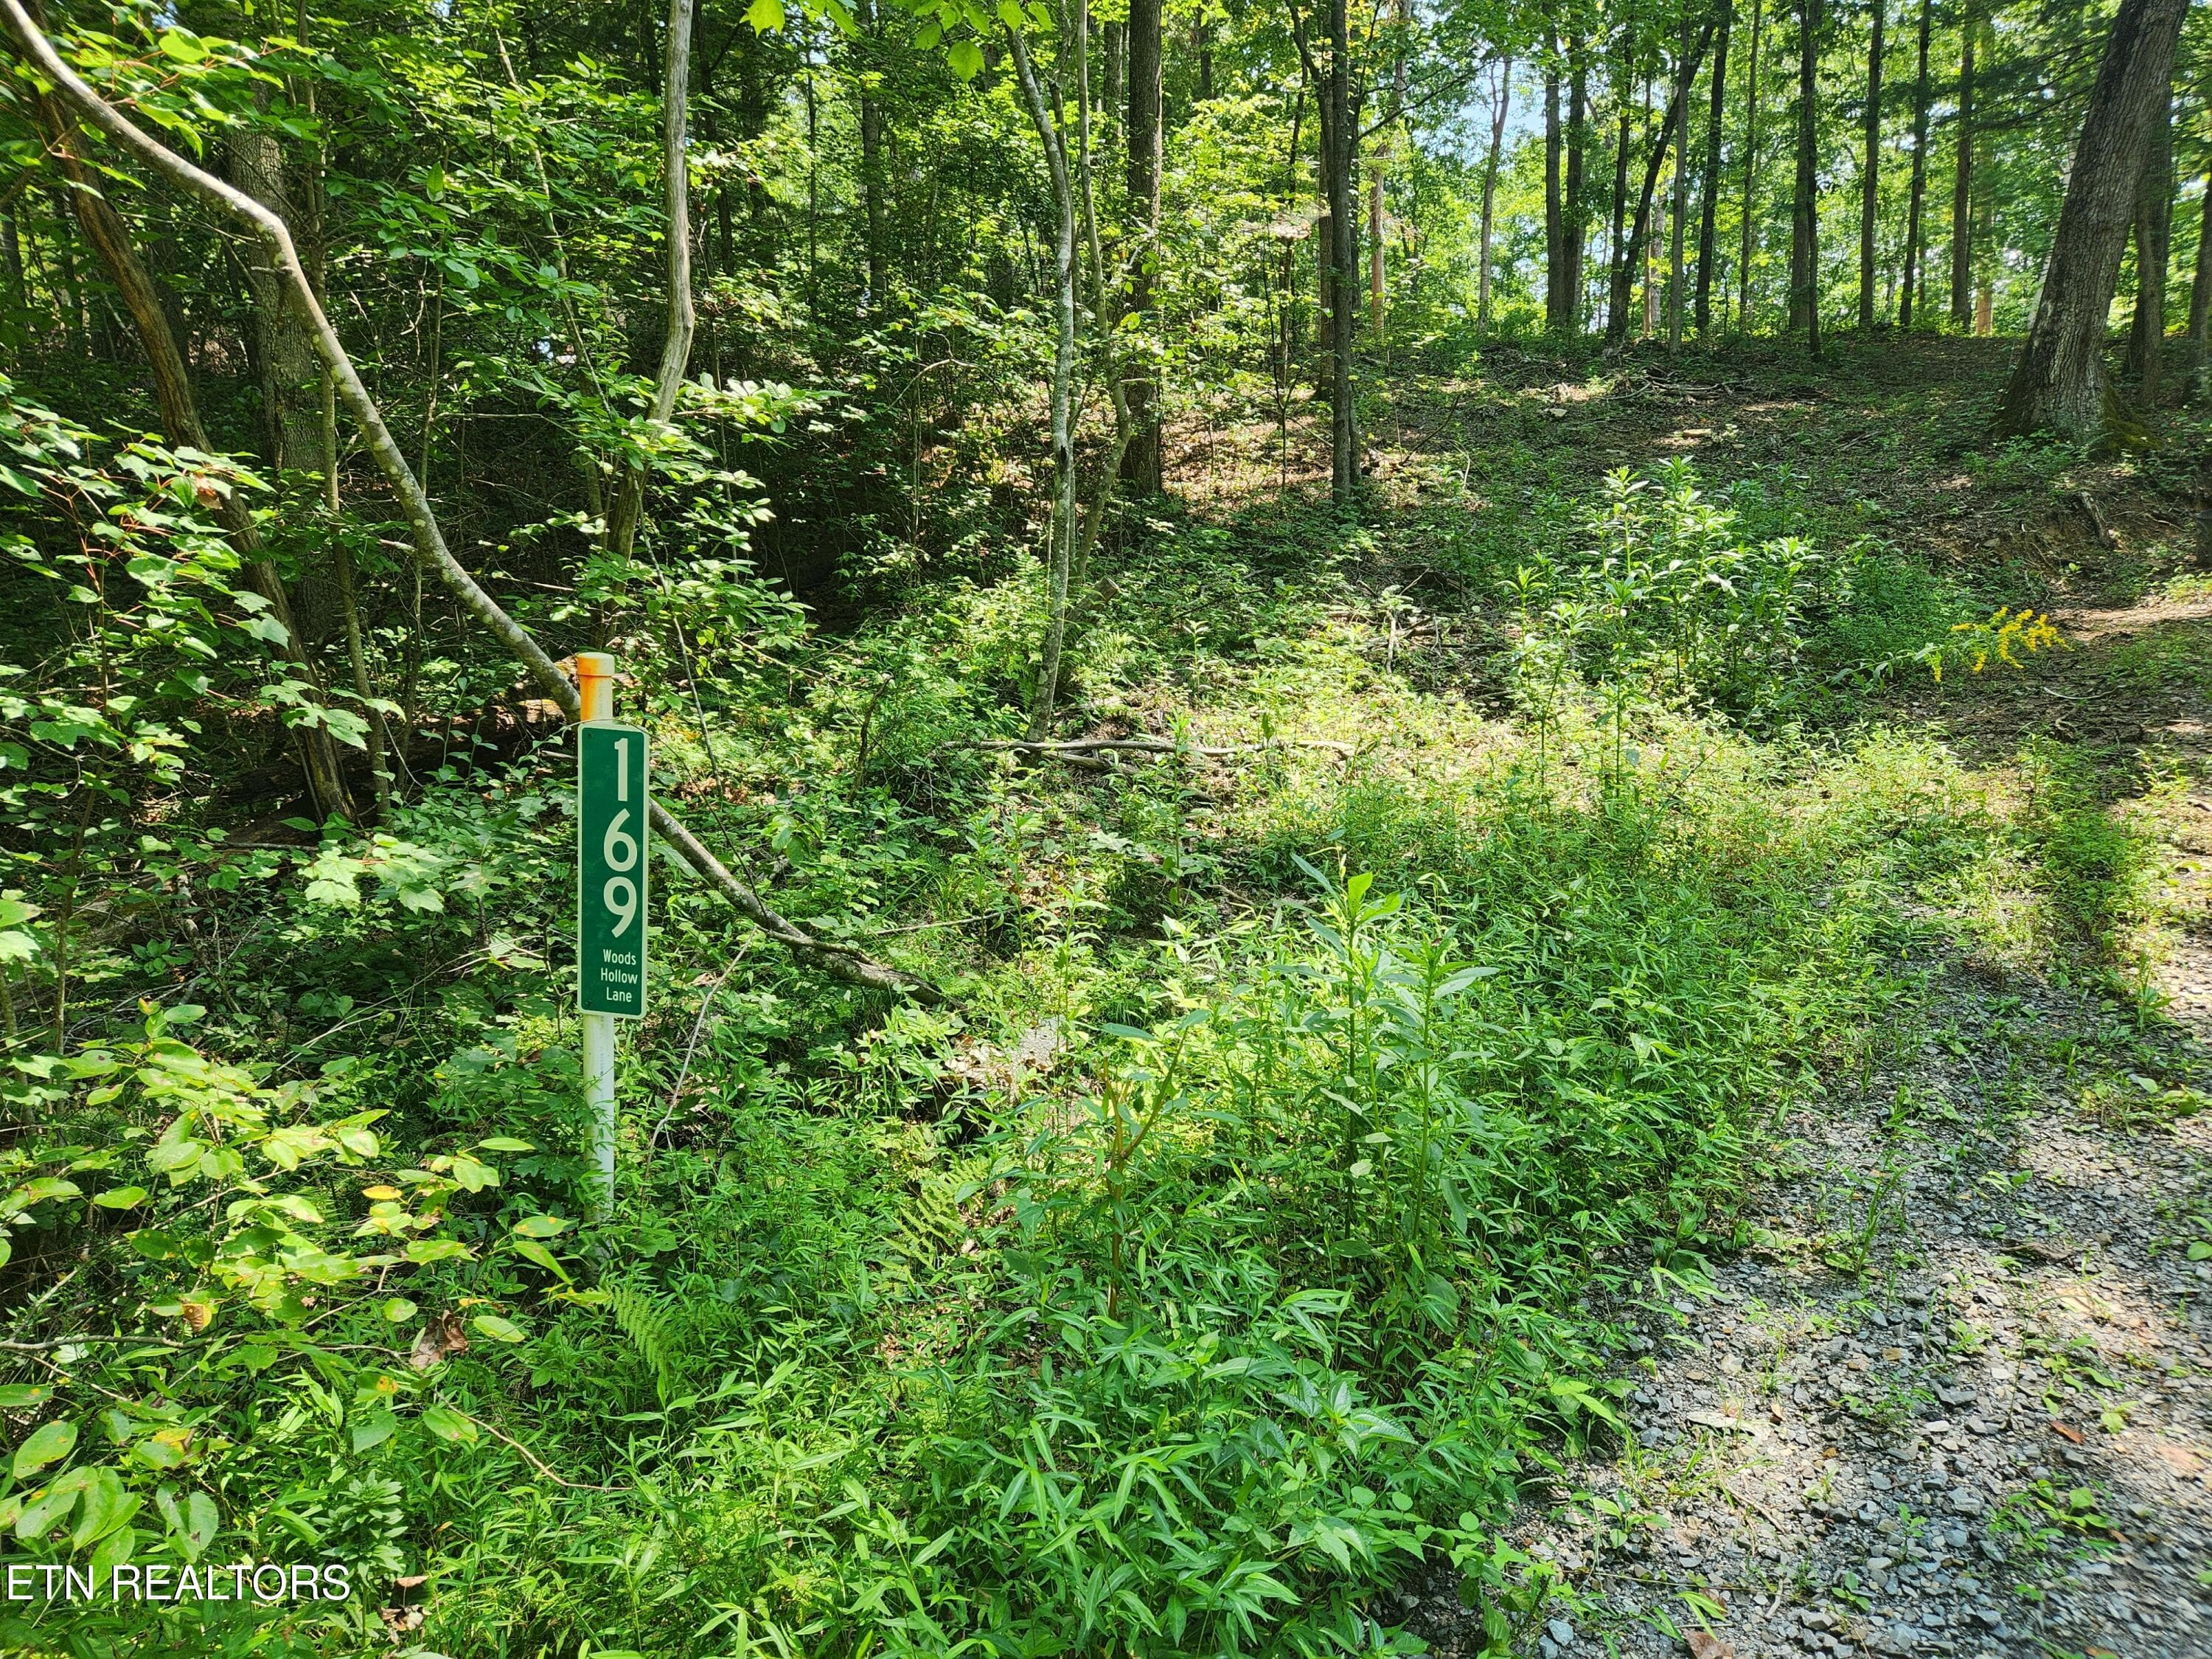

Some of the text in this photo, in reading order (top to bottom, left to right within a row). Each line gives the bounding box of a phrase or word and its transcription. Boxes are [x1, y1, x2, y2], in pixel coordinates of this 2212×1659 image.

[603, 737, 638, 938] 169
[603, 948, 636, 965] Woods
[600, 967, 638, 984] Hollow
[606, 987, 632, 1002] Lane
